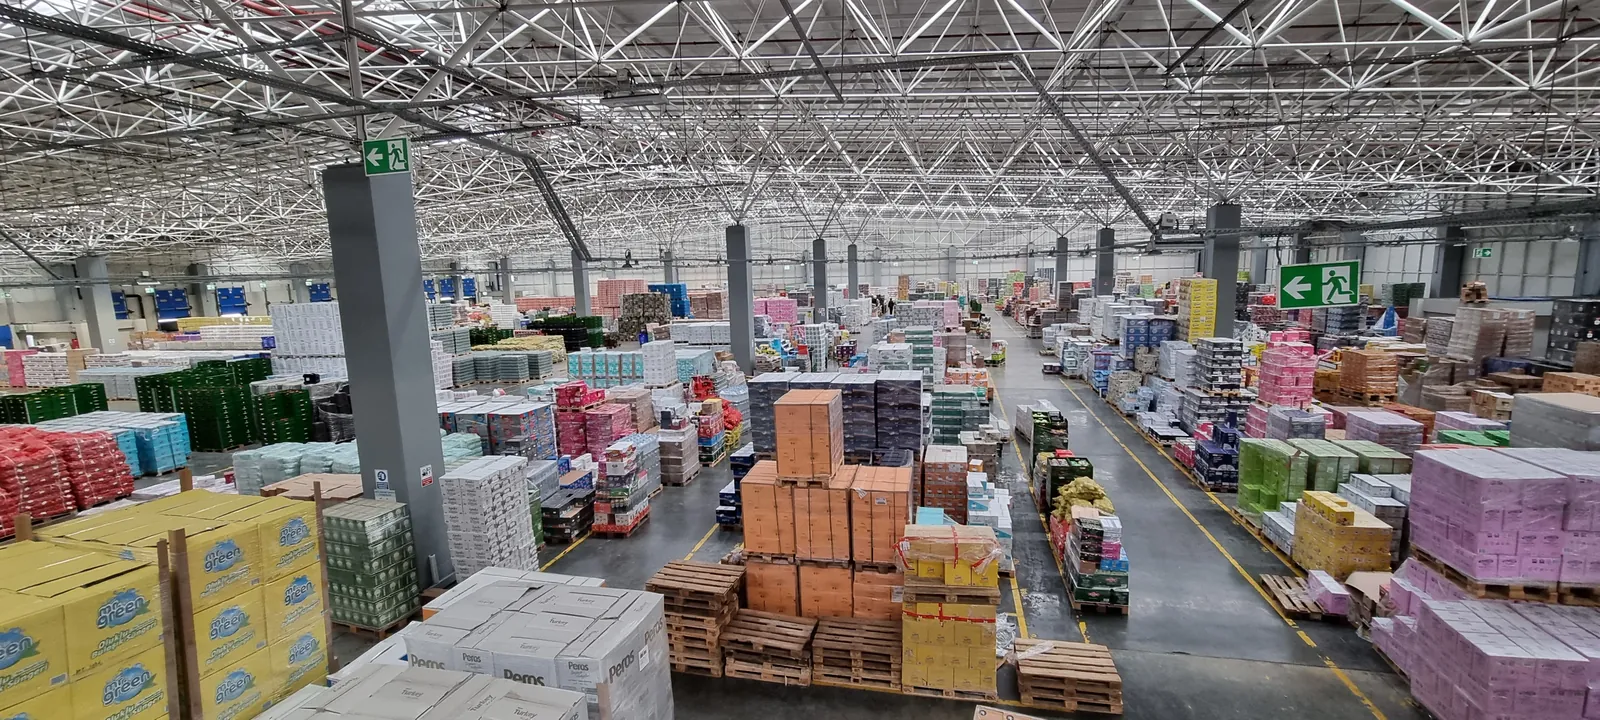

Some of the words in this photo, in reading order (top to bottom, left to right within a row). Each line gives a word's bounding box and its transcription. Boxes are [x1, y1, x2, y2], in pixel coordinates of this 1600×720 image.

[205, 547, 241, 573] green
[284, 581, 313, 607] green
[96, 596, 145, 630] green
[98, 601, 122, 617] mr.
[210, 611, 246, 641] green
[98, 630, 130, 651] Oluklu
[462, 652, 482, 664] Peros
[567, 661, 590, 672] Peros
[608, 649, 635, 685] Peros
[102, 670, 151, 706] green
[215, 673, 252, 705] green
[513, 706, 538, 719] Turkey
